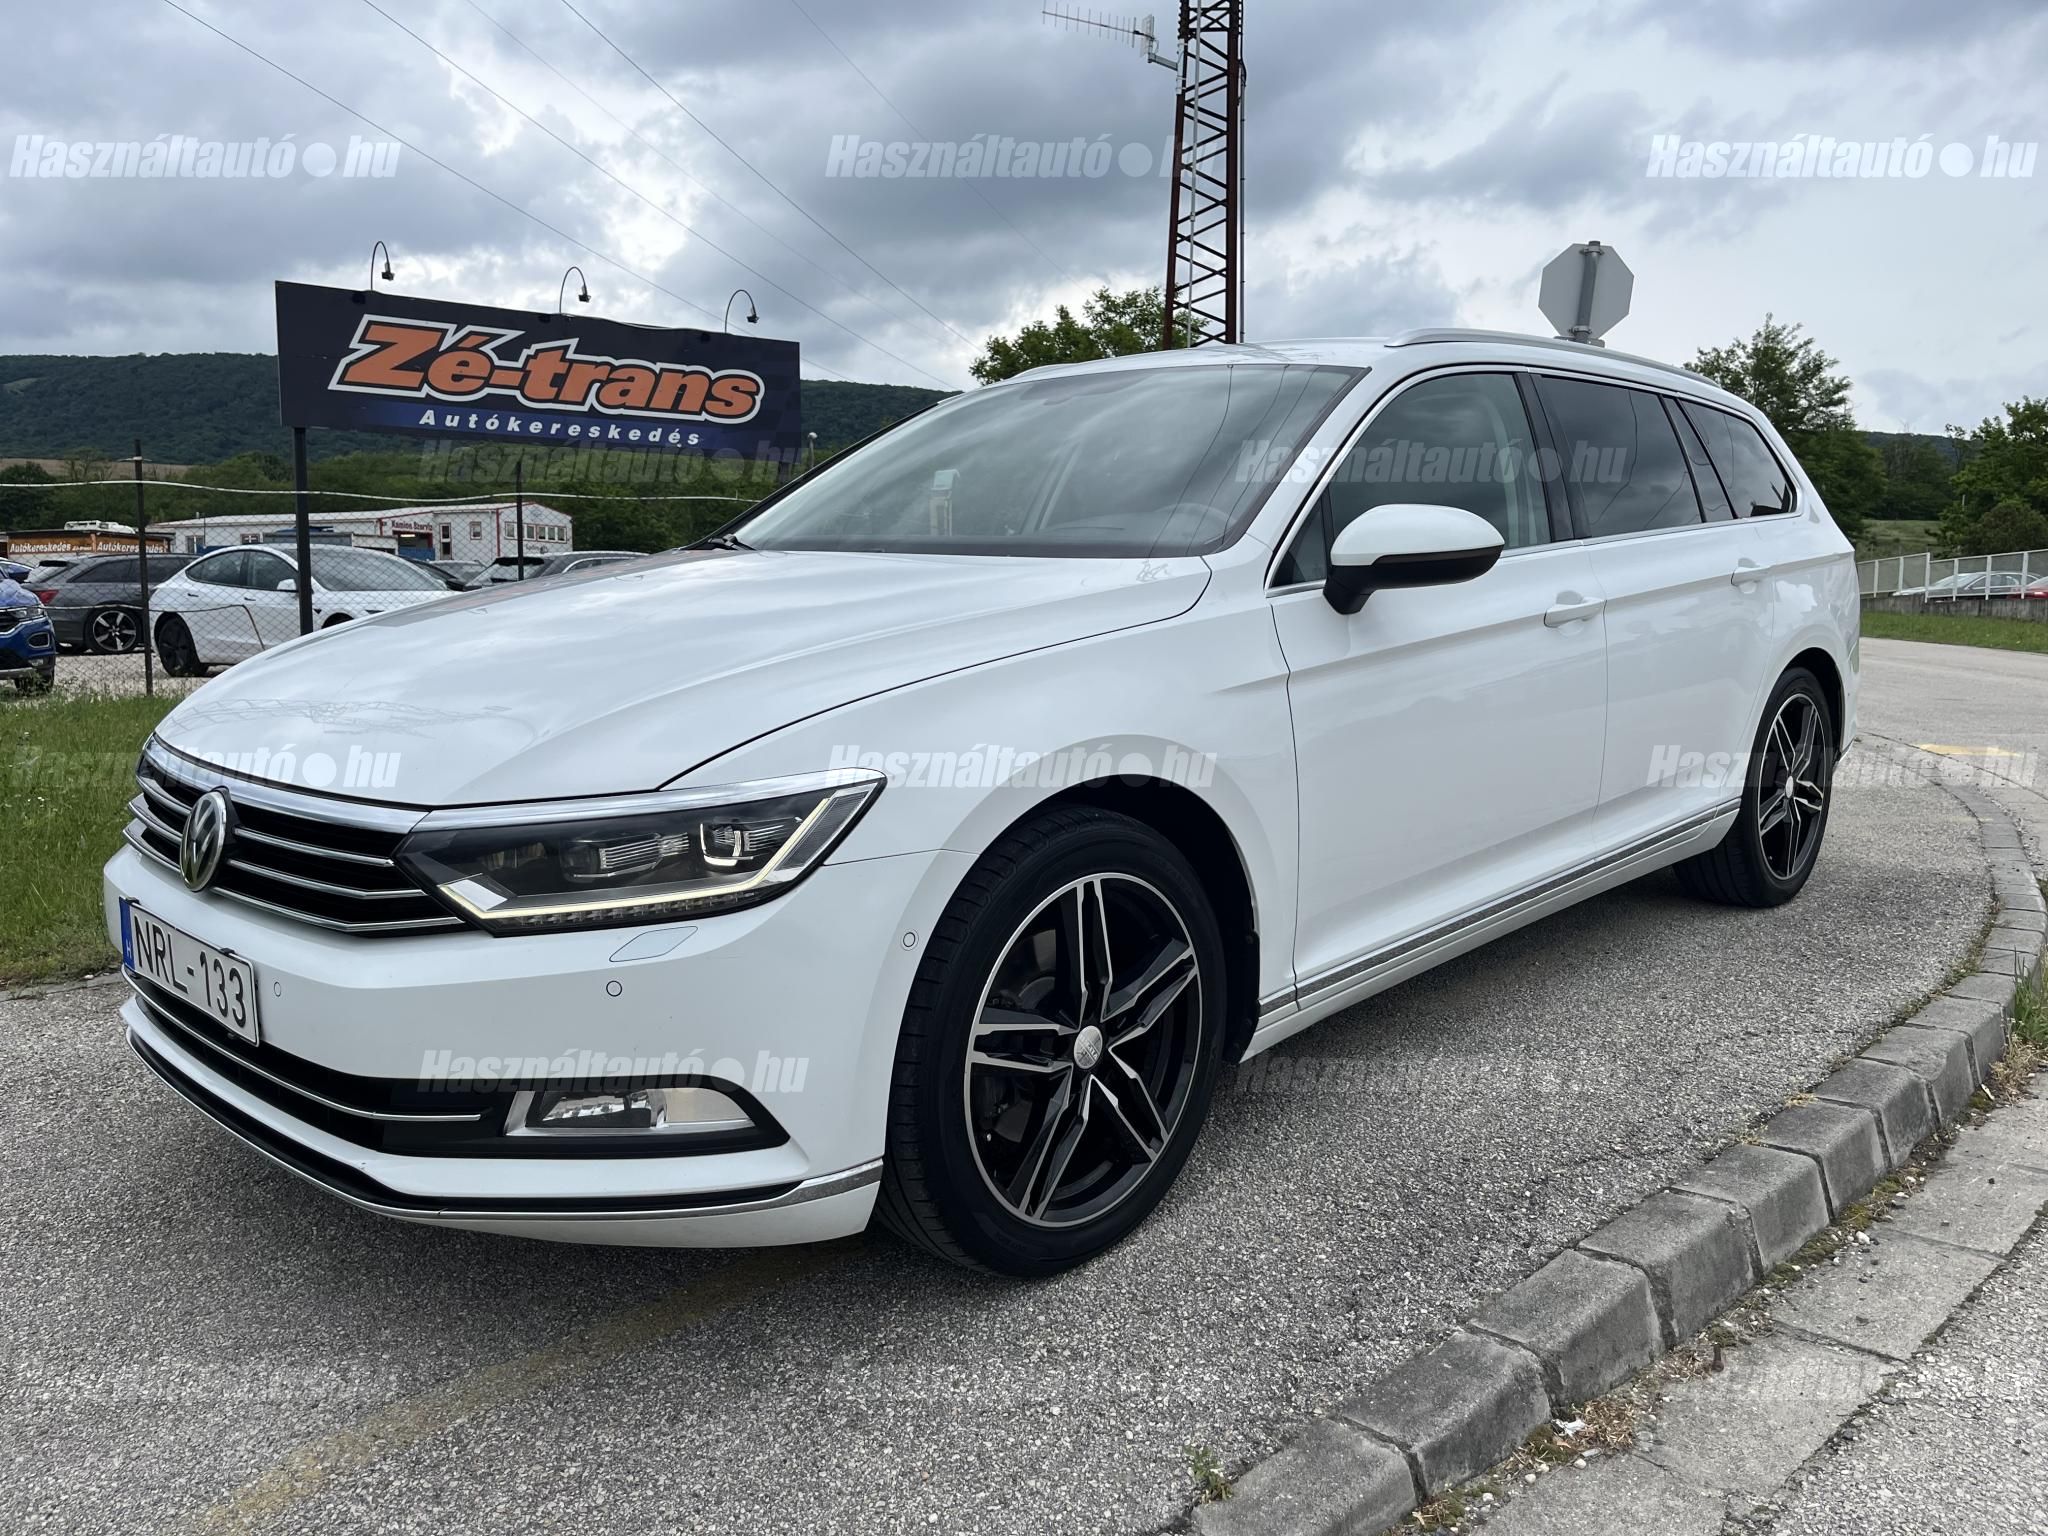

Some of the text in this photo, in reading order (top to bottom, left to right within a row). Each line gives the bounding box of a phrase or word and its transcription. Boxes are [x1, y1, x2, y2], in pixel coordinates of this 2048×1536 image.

[329, 314, 765, 424] Zé-trans
[418, 408, 700, 446] Autókereskedés
[97, 541, 165, 553] Autókeresedés
[126, 938, 133, 959] H
[133, 914, 247, 1028] NRL-133
